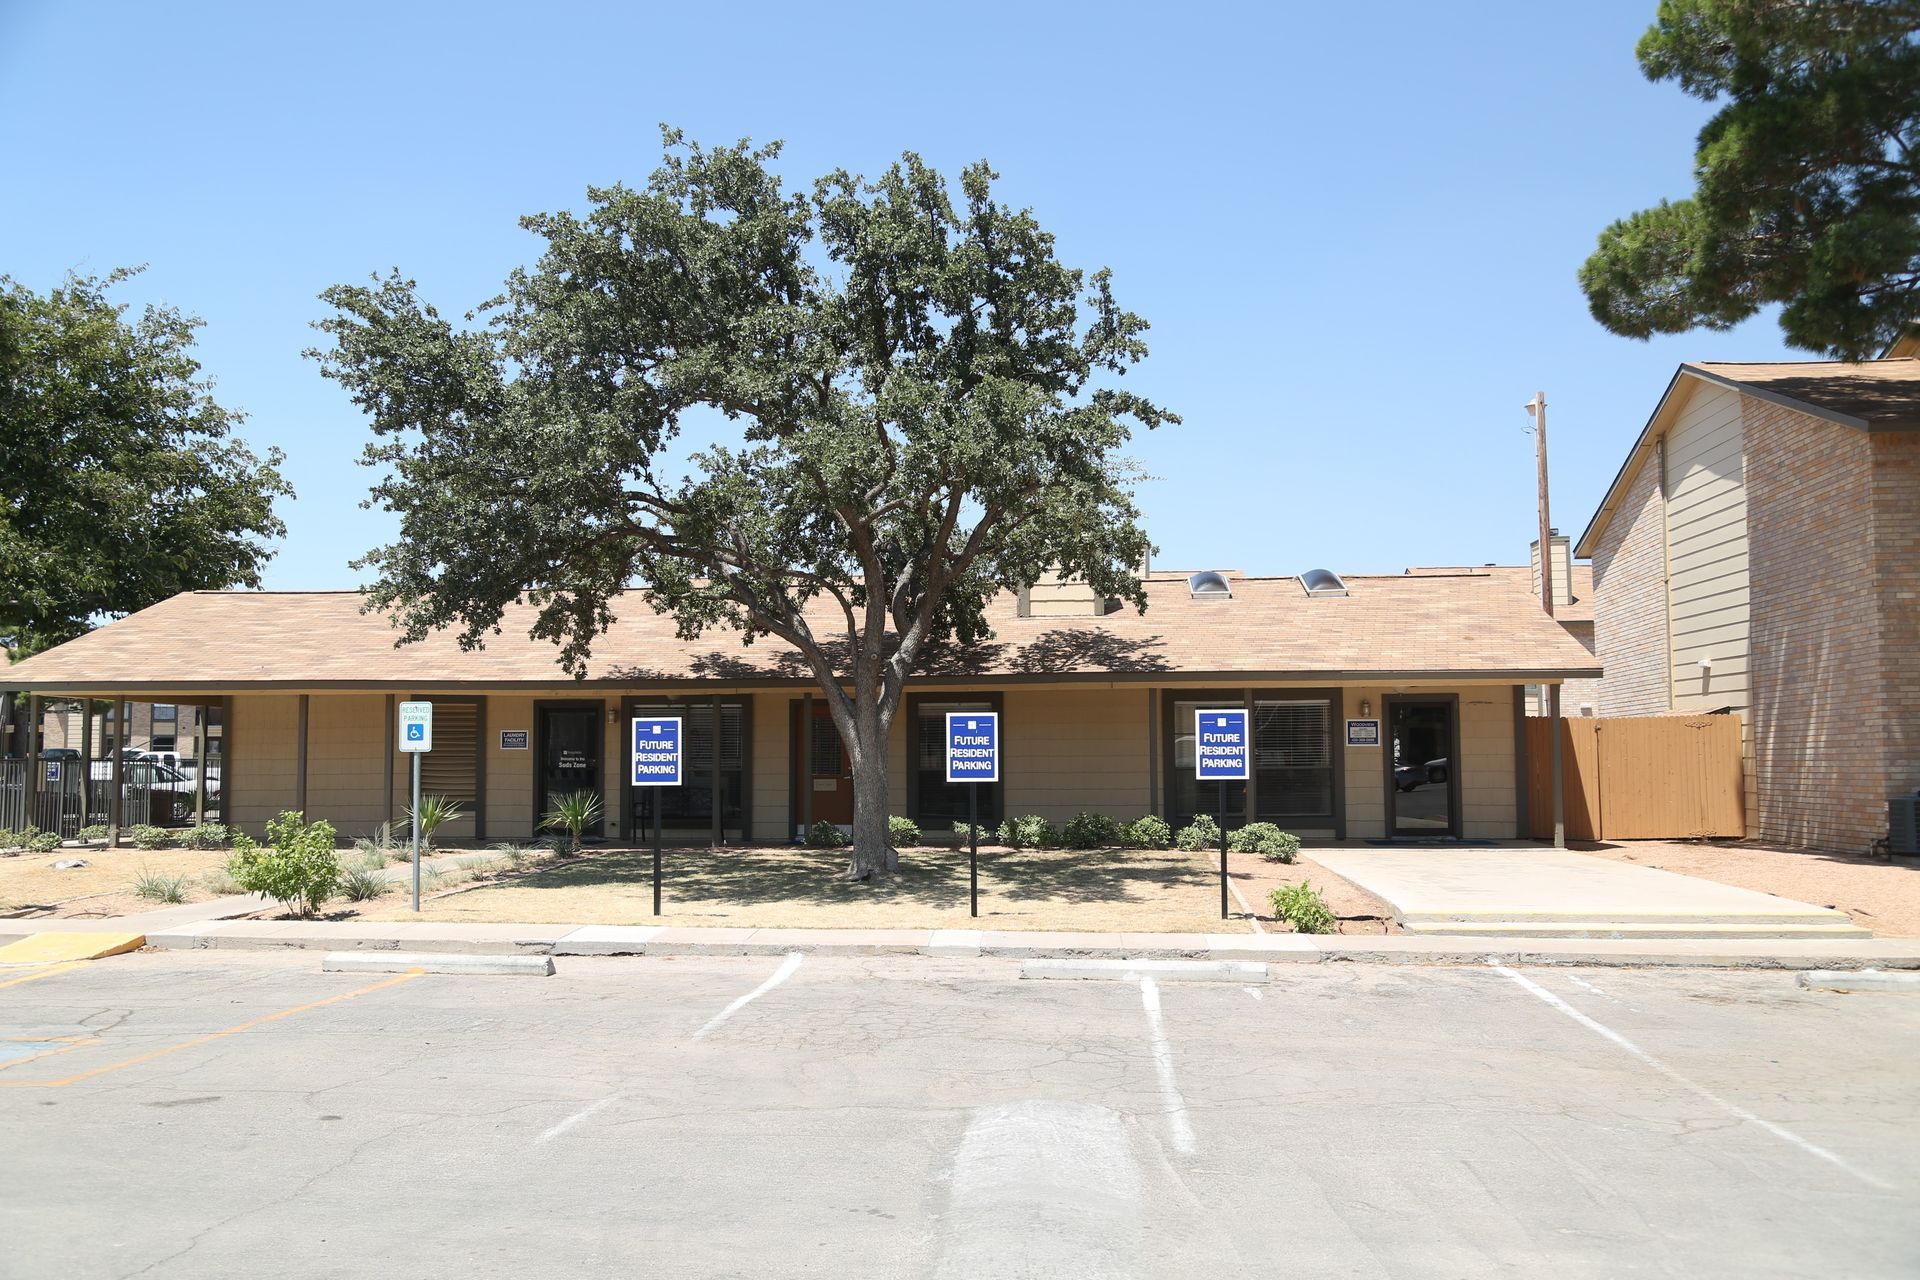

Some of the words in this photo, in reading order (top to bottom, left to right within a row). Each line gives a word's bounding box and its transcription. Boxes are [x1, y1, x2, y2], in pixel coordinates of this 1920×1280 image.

[954, 735, 990, 745] FUTURE
[1203, 732, 1241, 743] FUTURE
[639, 739, 674, 750] FUTURE
[950, 747, 994, 758] RESIDENT
[1199, 745, 1244, 756] RESIDENT
[635, 752, 678, 762] RESIDENT
[952, 760, 992, 770] PARKING
[1202, 758, 1242, 768] PARKING
[638, 764, 676, 774] PARKING
